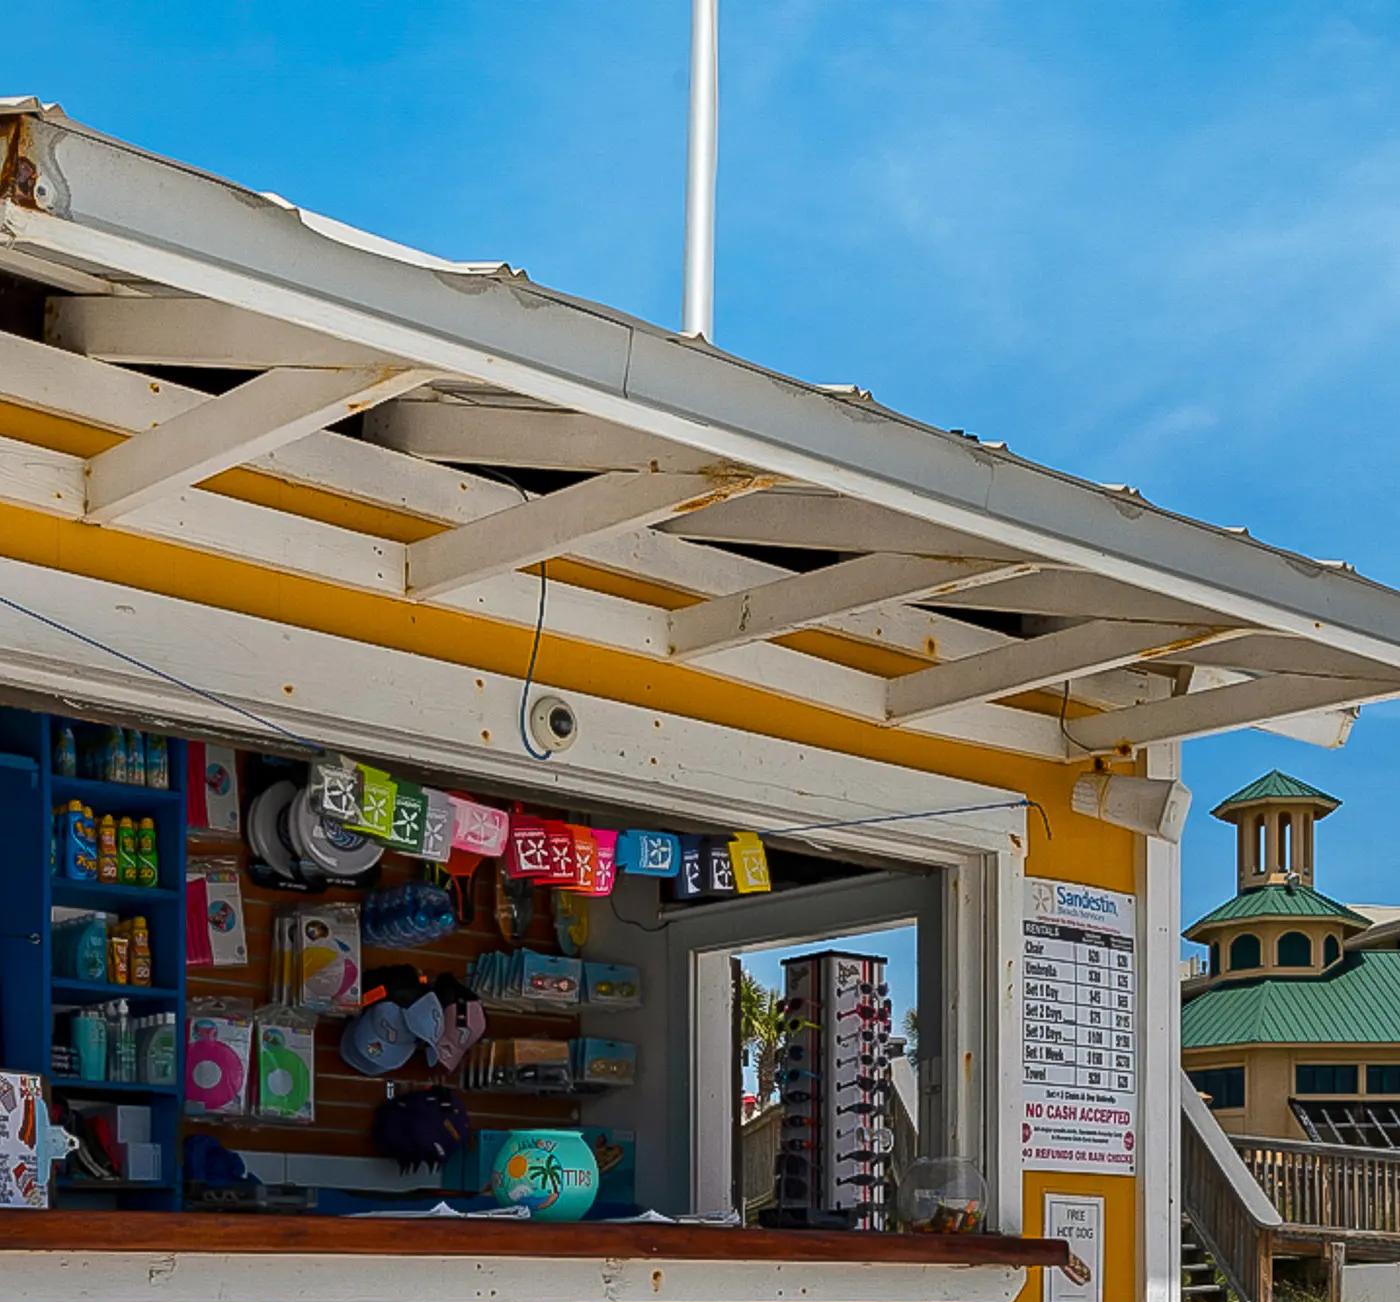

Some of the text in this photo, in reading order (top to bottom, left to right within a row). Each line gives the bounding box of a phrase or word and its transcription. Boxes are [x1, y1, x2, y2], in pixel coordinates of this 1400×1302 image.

[1057, 886, 1117, 914] Sandestin
[1026, 924, 1059, 937] RENTALS
[1025, 941, 1044, 954] Chair
[1026, 961, 1057, 977] Umbrella
[1045, 984, 1058, 1000] Day
[1024, 1066, 1046, 1080] Towel
[1026, 1103, 1130, 1125] NO CASH ACCEPTED
[1035, 1149, 1074, 1161] REFUNDS
[1075, 1151, 1087, 1161] OR
[563, 1169, 592, 1188] TIPS
[1067, 1209, 1085, 1221] FREE
[1057, 1227, 1094, 1239] HOT DOG
